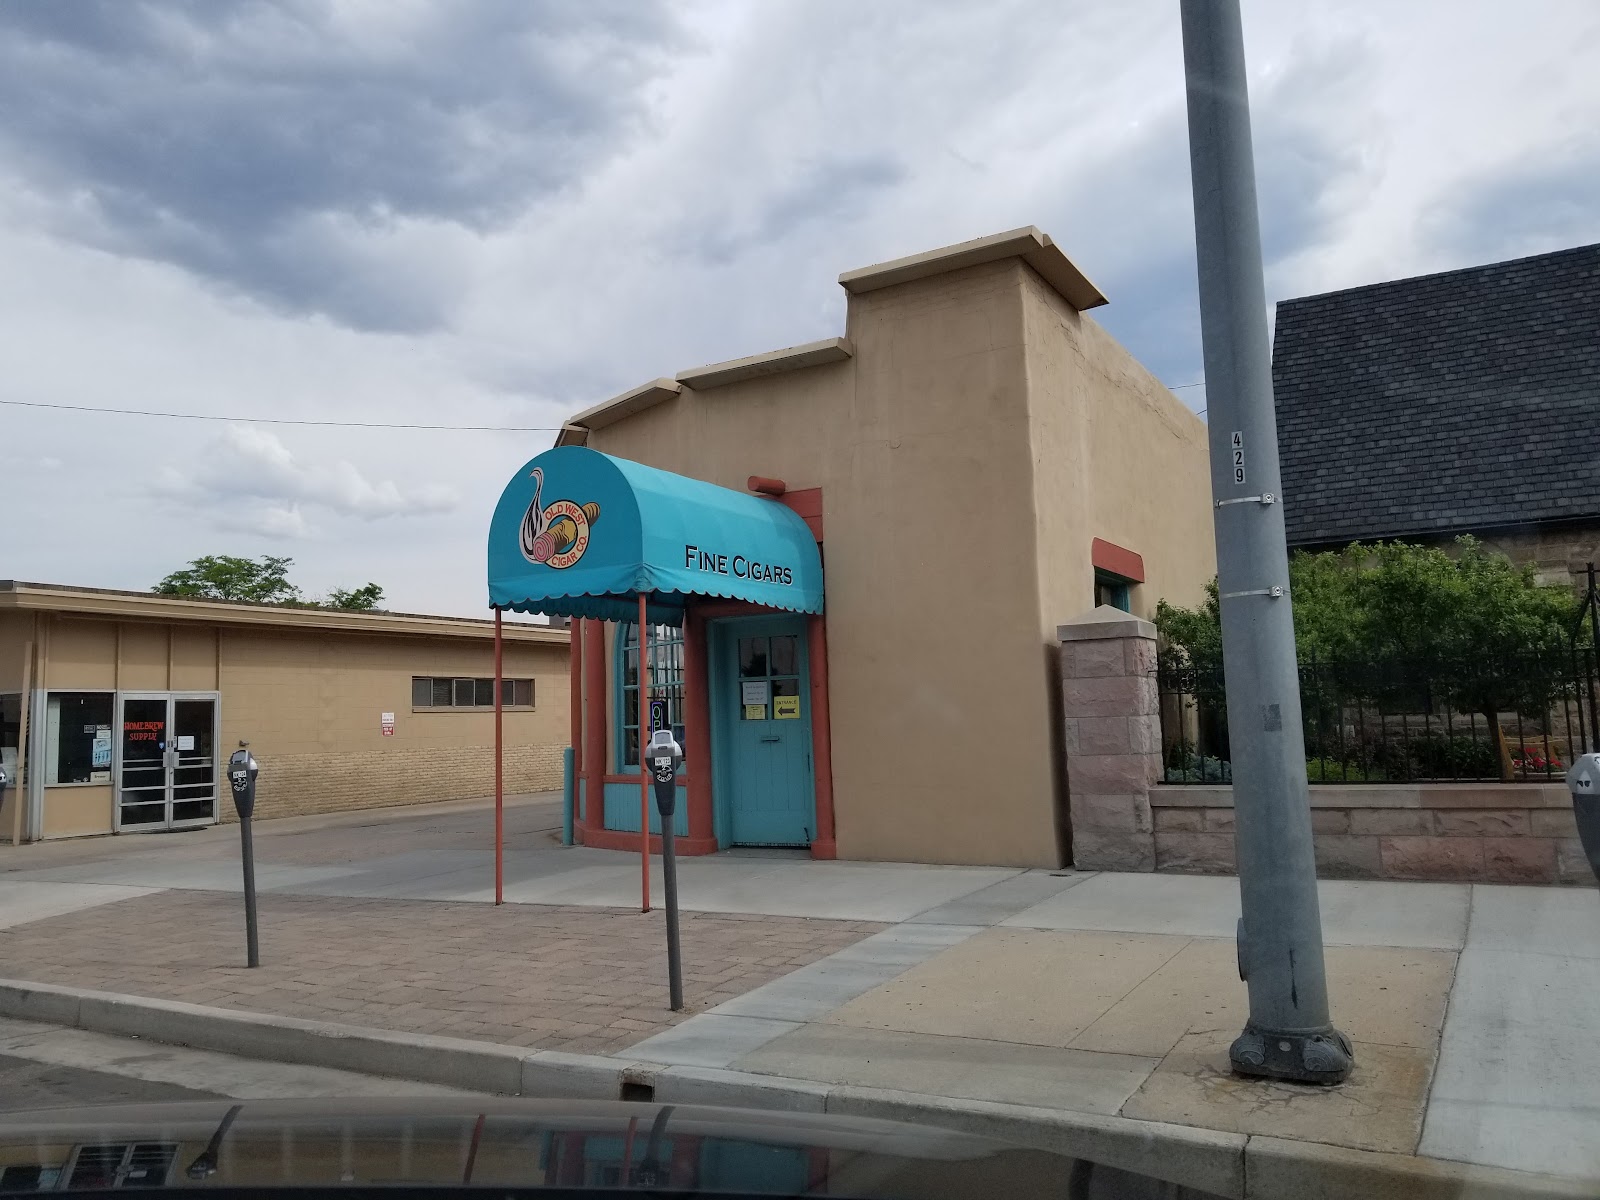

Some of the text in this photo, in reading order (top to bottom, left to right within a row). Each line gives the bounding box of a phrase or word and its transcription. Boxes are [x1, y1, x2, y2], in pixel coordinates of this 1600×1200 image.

[1233, 432, 1244, 483] 429
[545, 503, 586, 526] OLD WEST
[551, 535, 588, 567] CIGAR CO.
[685, 544, 793, 586] FINE CIGARS
[124, 721, 164, 732] HOMEBREW
[653, 705, 661, 731] OP
[128, 732, 158, 741] SUPPLY
